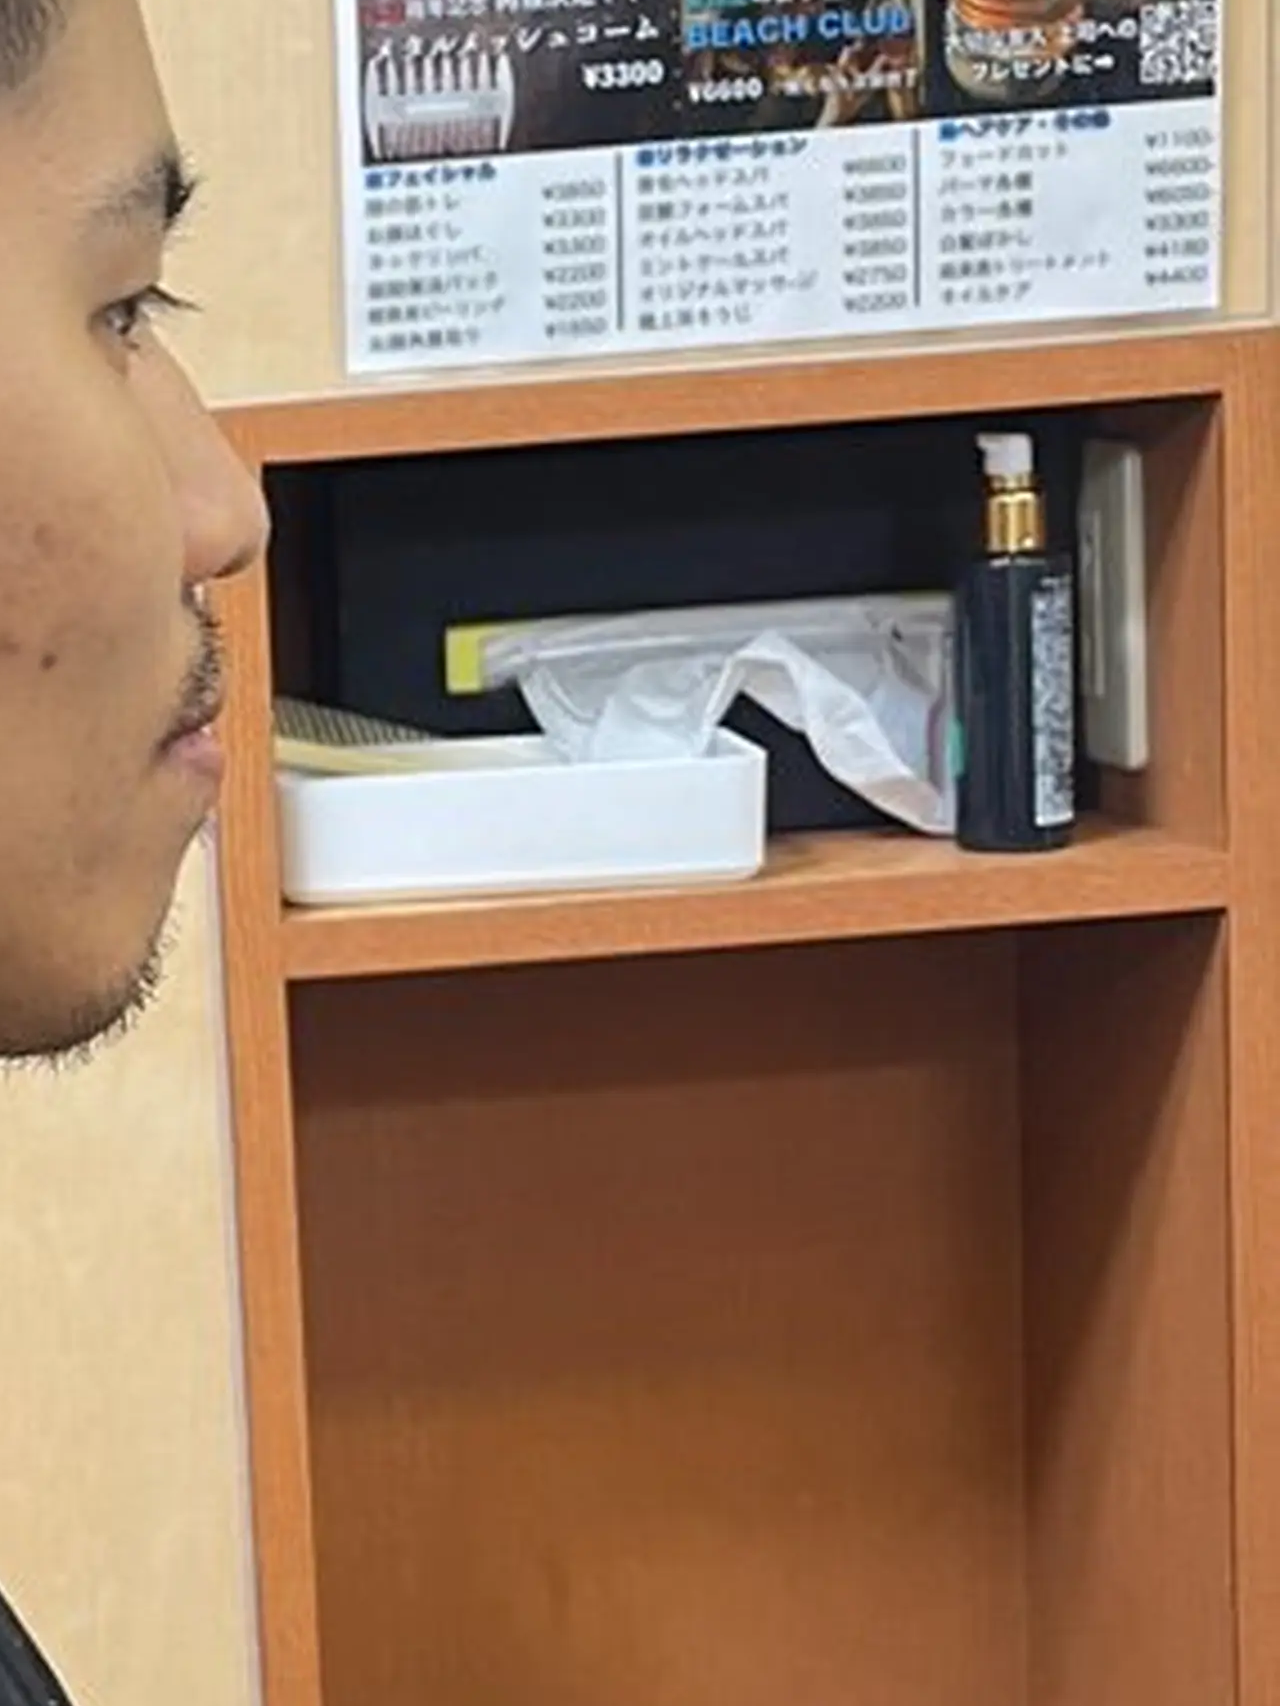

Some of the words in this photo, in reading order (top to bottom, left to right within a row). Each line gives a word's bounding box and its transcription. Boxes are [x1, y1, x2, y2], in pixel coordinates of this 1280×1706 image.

[686, 13, 807, 51] BEACH
[817, 6, 914, 41] CLUB
[581, 58, 667, 90] ¥3300
